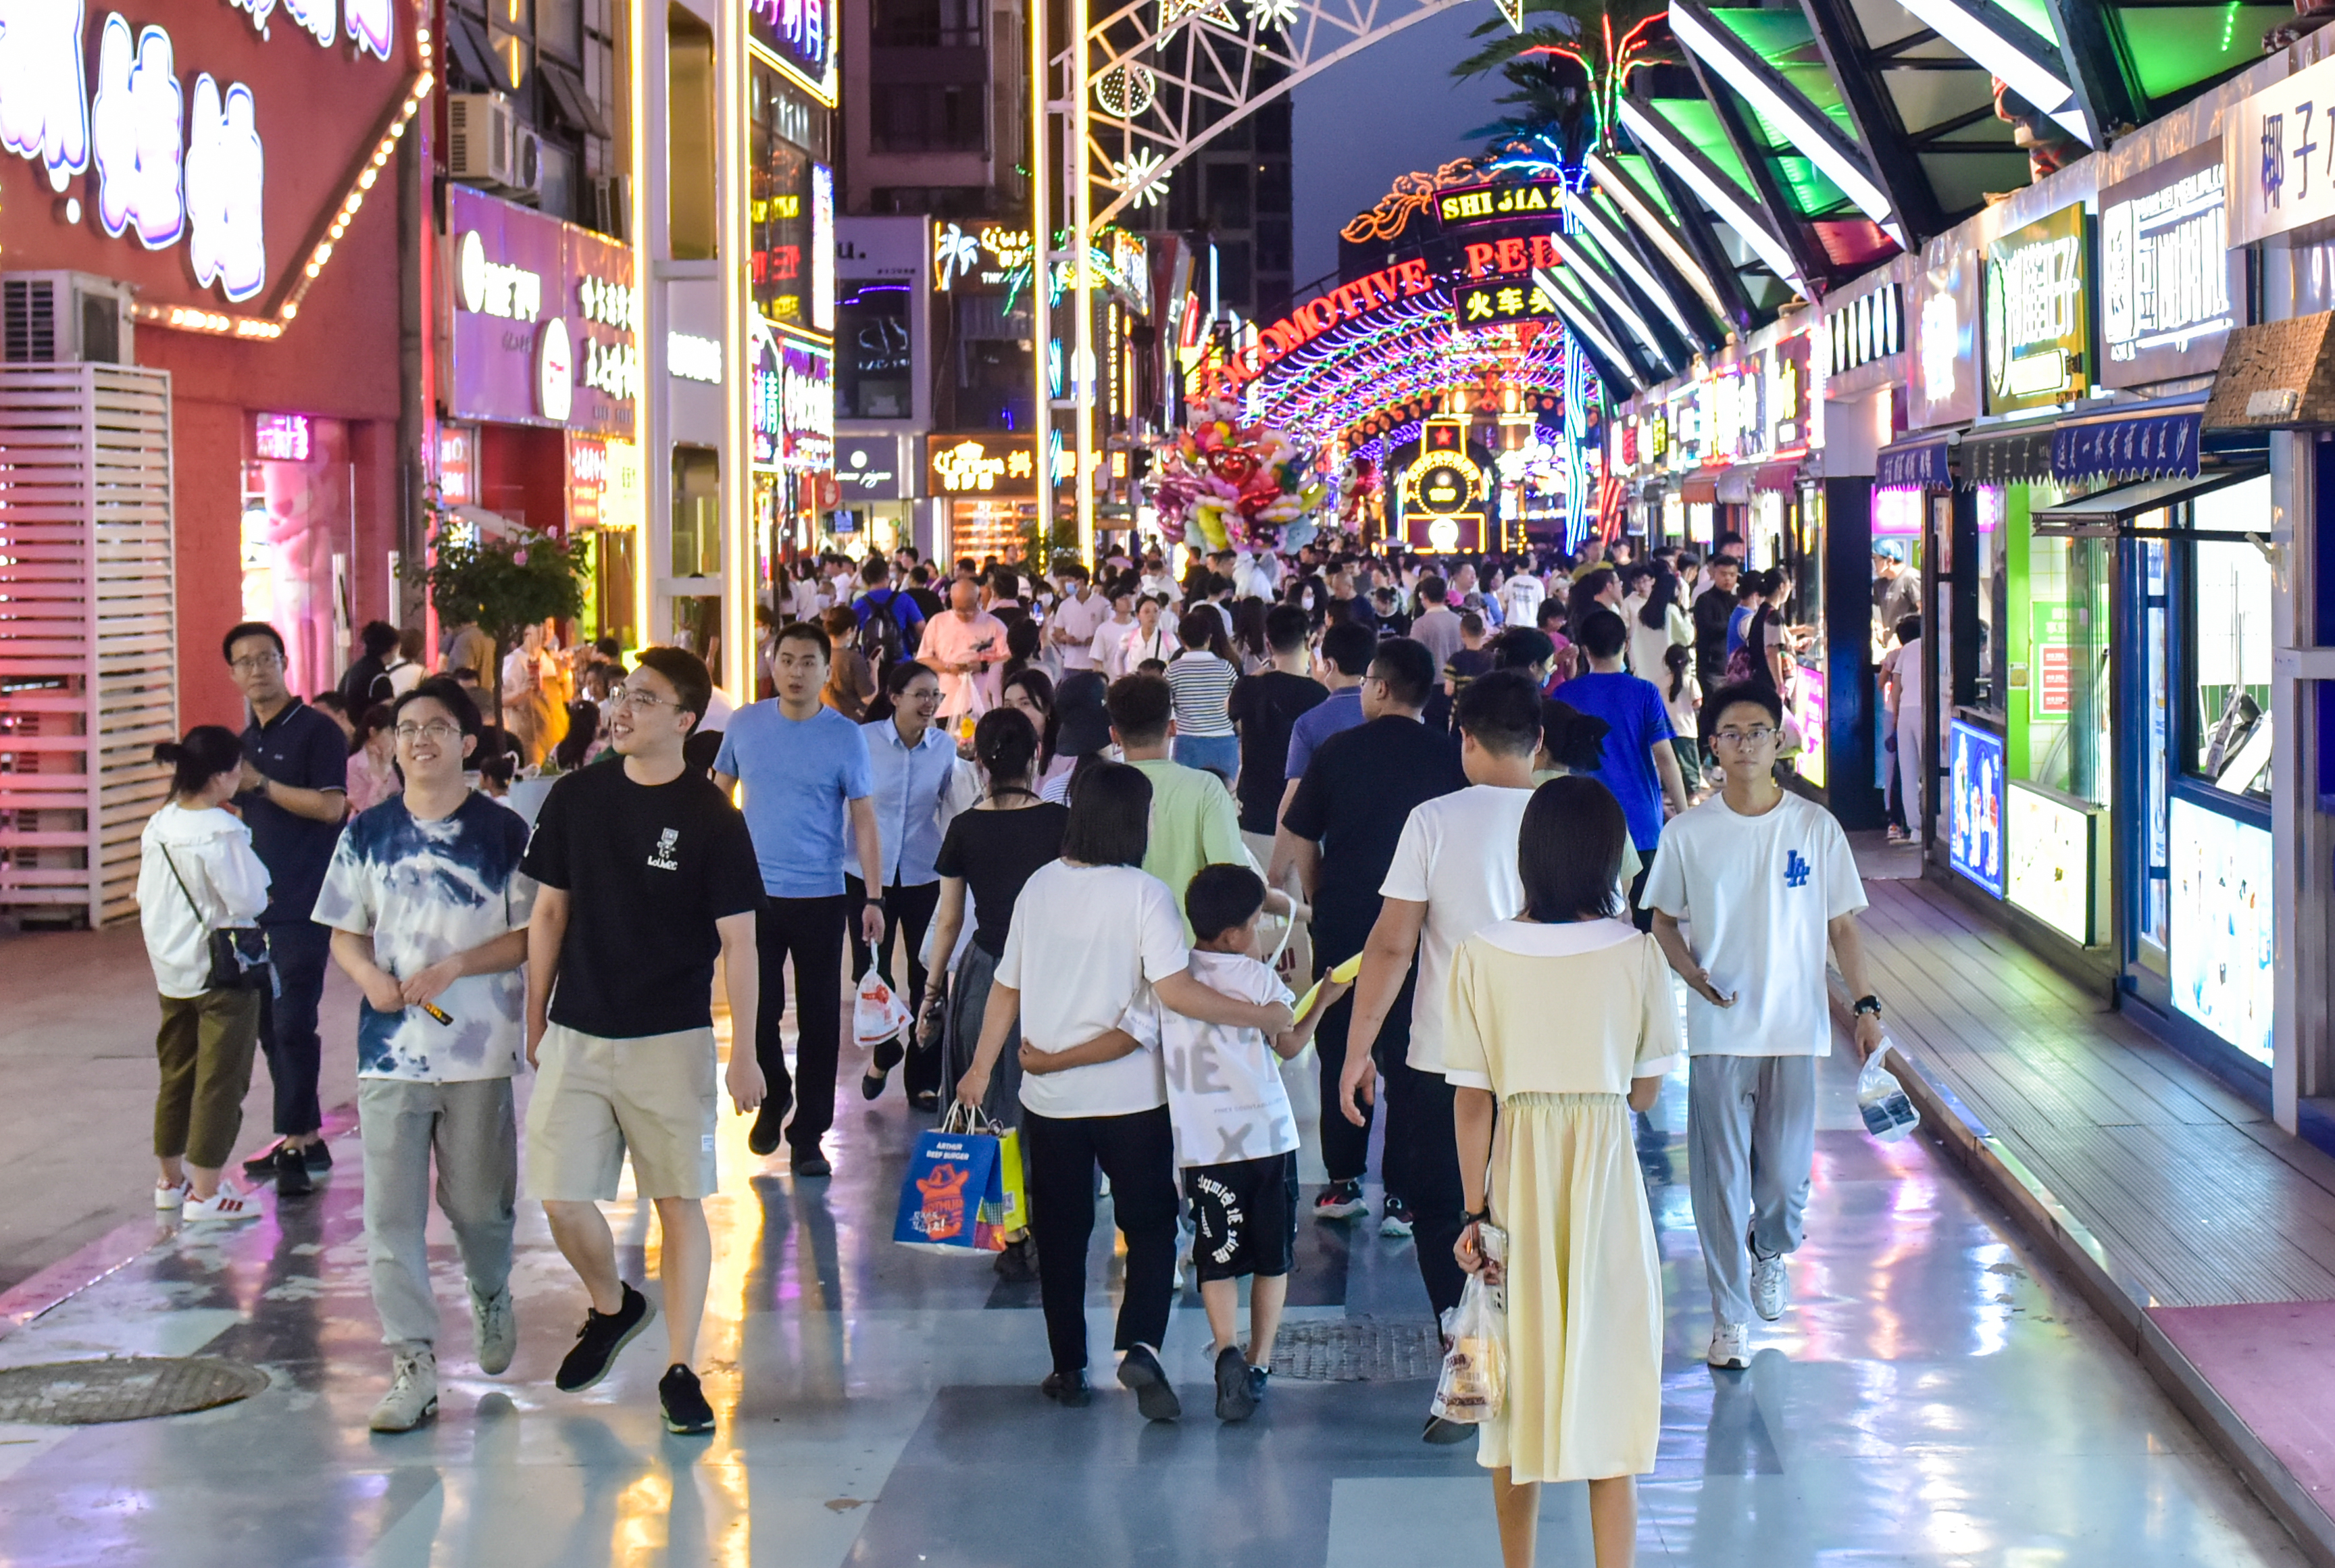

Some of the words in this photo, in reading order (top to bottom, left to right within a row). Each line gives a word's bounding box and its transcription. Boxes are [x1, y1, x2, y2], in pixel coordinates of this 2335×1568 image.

[1442, 192, 1493, 220] SHI
[1498, 187, 1547, 211] JIA
[1184, 258, 1433, 405] OCOMOTIVE
